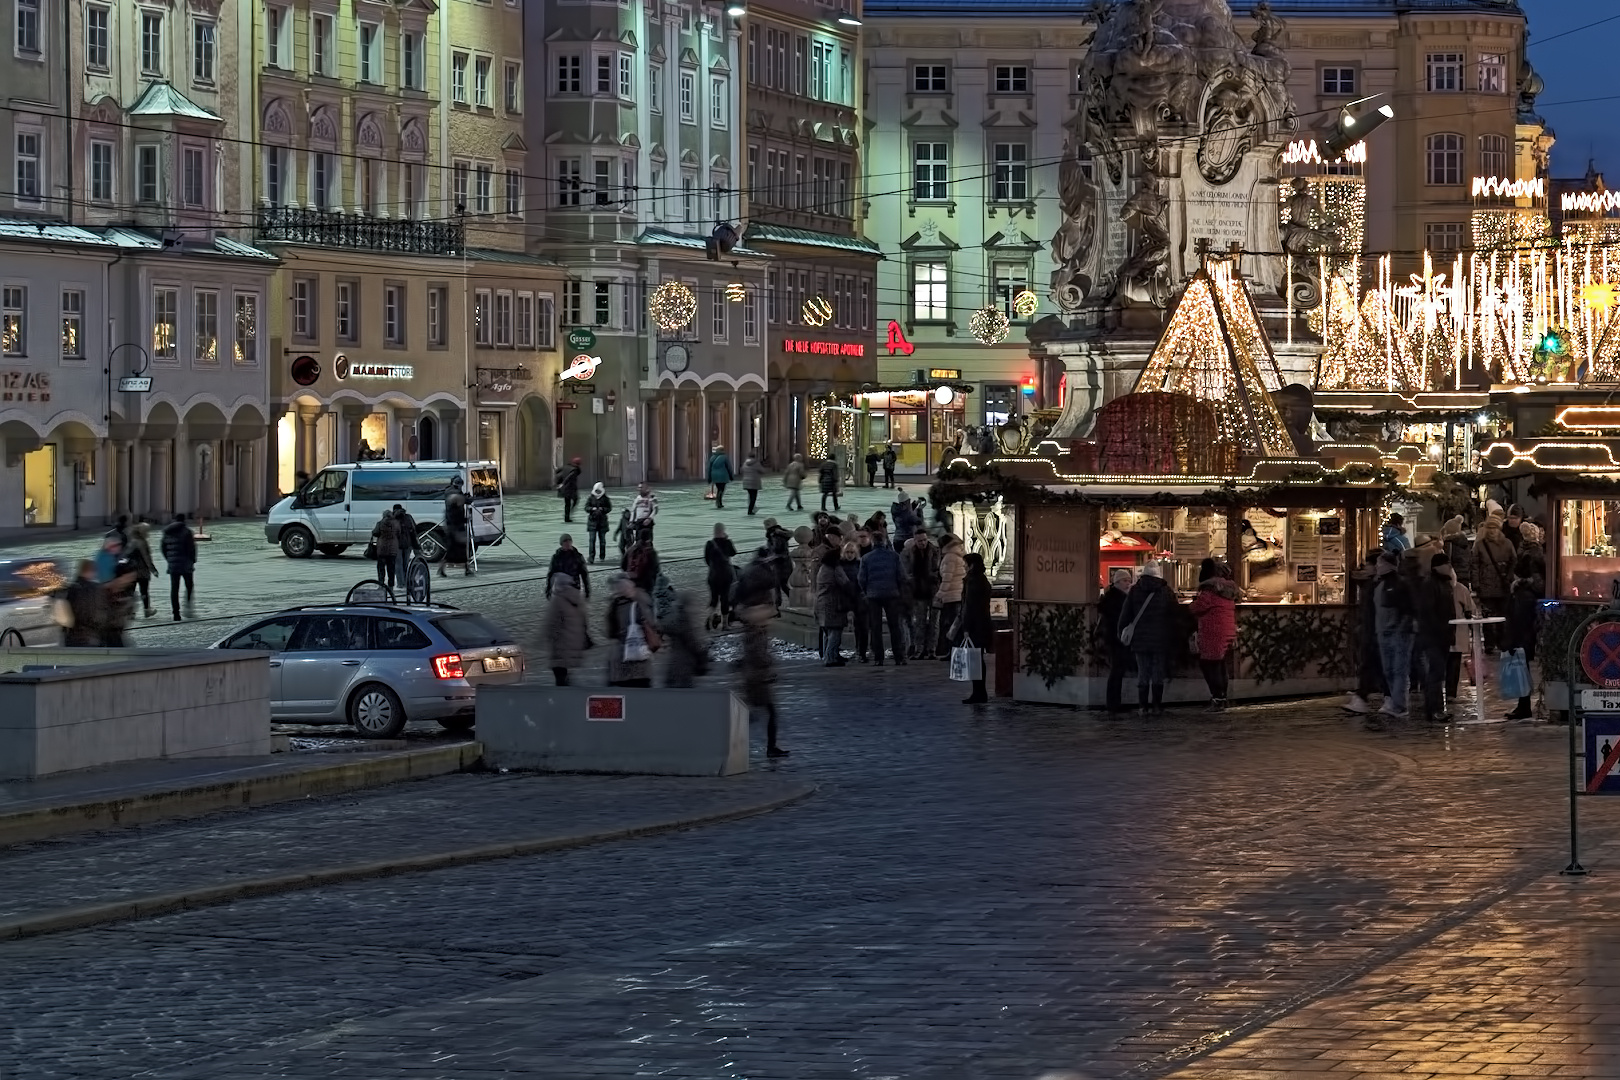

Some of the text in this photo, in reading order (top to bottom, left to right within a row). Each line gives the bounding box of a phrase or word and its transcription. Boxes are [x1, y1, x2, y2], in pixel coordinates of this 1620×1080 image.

[490, 383, 512, 392] Agfa
[1037, 555, 1075, 573] Schatz
[1604, 678, 1620, 687] ENDE
